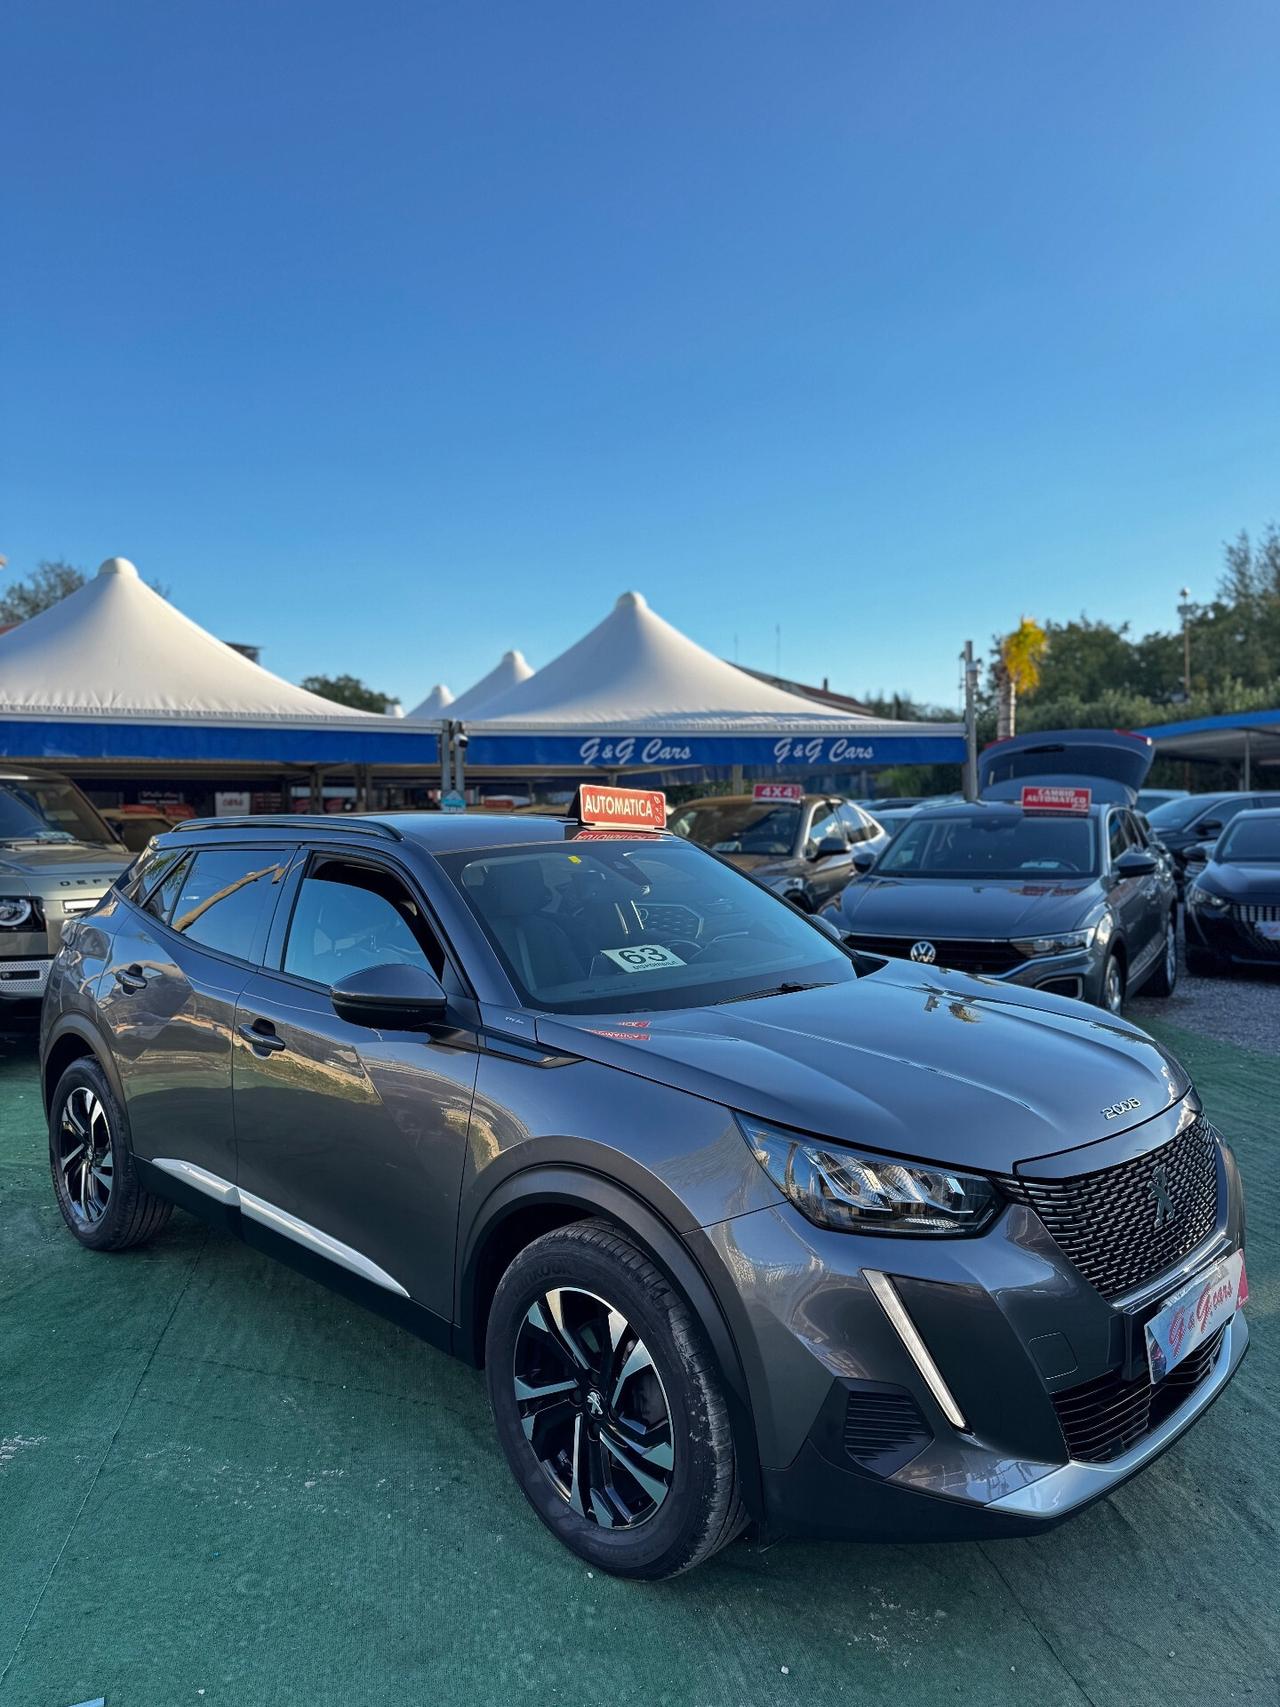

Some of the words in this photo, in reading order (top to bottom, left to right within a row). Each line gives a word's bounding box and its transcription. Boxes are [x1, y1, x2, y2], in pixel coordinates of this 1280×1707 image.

[580, 738, 635, 764] G&G
[642, 739, 691, 763] Cars
[773, 738, 824, 764] G&G
[828, 739, 873, 762] Cars
[1025, 795, 1086, 804] AUTOMATICO
[1038, 788, 1075, 797] CAMBIO
[584, 794, 653, 818] AUTOMATICA
[619, 947, 668, 964] 63
[1102, 1098, 1141, 1120] 2008
